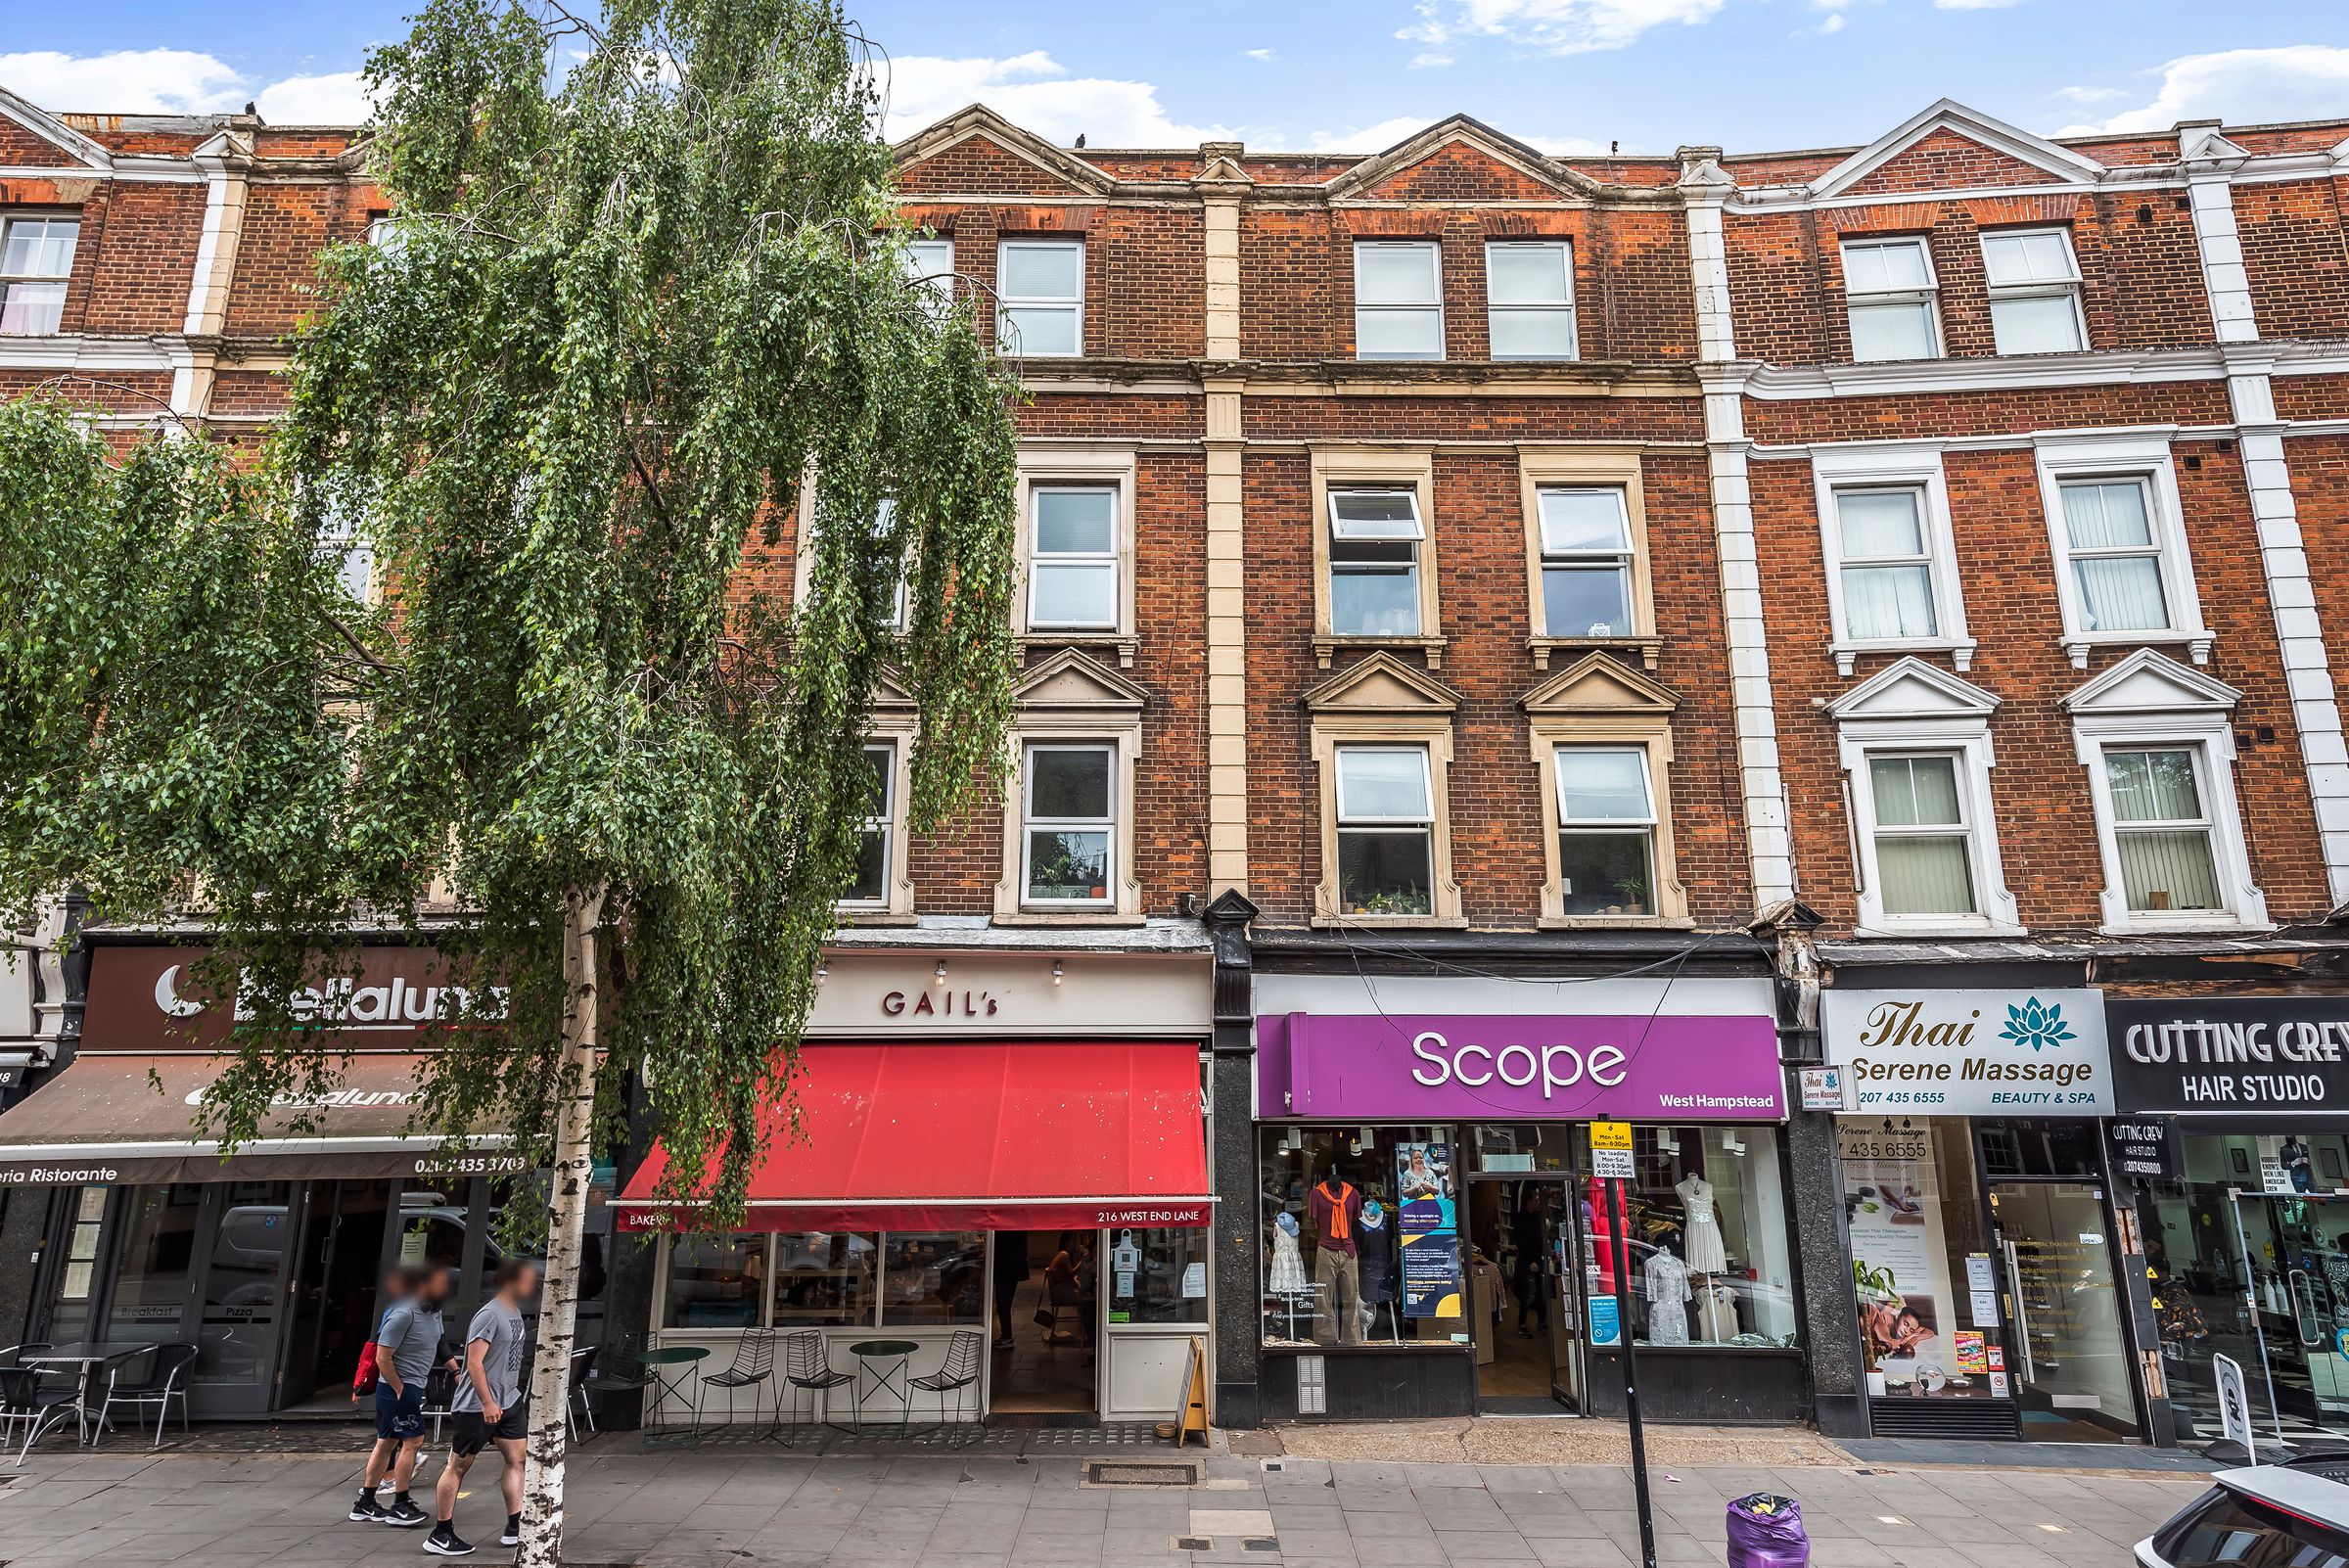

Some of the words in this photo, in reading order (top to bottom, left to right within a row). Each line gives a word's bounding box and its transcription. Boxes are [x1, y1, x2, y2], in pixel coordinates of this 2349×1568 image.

[883, 990, 998, 1016] GAIL's
[1859, 1000, 1981, 1047] Thai
[2125, 1019, 2274, 1064] CUTTING
[1411, 1031, 1628, 1099] Scope
[1851, 1057, 1952, 1081] Serene
[1960, 1057, 2093, 1086] Massage
[1805, 1072, 1822, 1087] Thai
[2182, 1076, 2237, 1101] HAIR
[2242, 1074, 2326, 1101] STUDIO
[1659, 1094, 1694, 1108] West
[1695, 1094, 1774, 1110] Hampstead
[1886, 1092, 1910, 1103] 435
[1912, 1091, 1945, 1103] 6555
[1991, 1092, 2051, 1103] BEAUTY
[2054, 1092, 2064, 1103] &
[2066, 1092, 2096, 1103] SPA
[1877, 1125, 1926, 1140] Massage
[2113, 1125, 2142, 1140] CUTTING
[2143, 1126, 2163, 1141] CREW
[1849, 1142, 1880, 1157] 435
[1885, 1142, 1926, 1157] 6555
[2125, 1146, 2138, 1155] HAIR
[0, 1170, 25, 1183] ria
[29, 1168, 117, 1182] Ristorante
[1097, 1212, 1118, 1222] 216
[1120, 1211, 1147, 1222] WEST
[1150, 1211, 1172, 1221] END
[1174, 1211, 1200, 1221] LANE
[121, 1307, 173, 1316] Breakfast
[225, 1307, 253, 1316] Pizza
